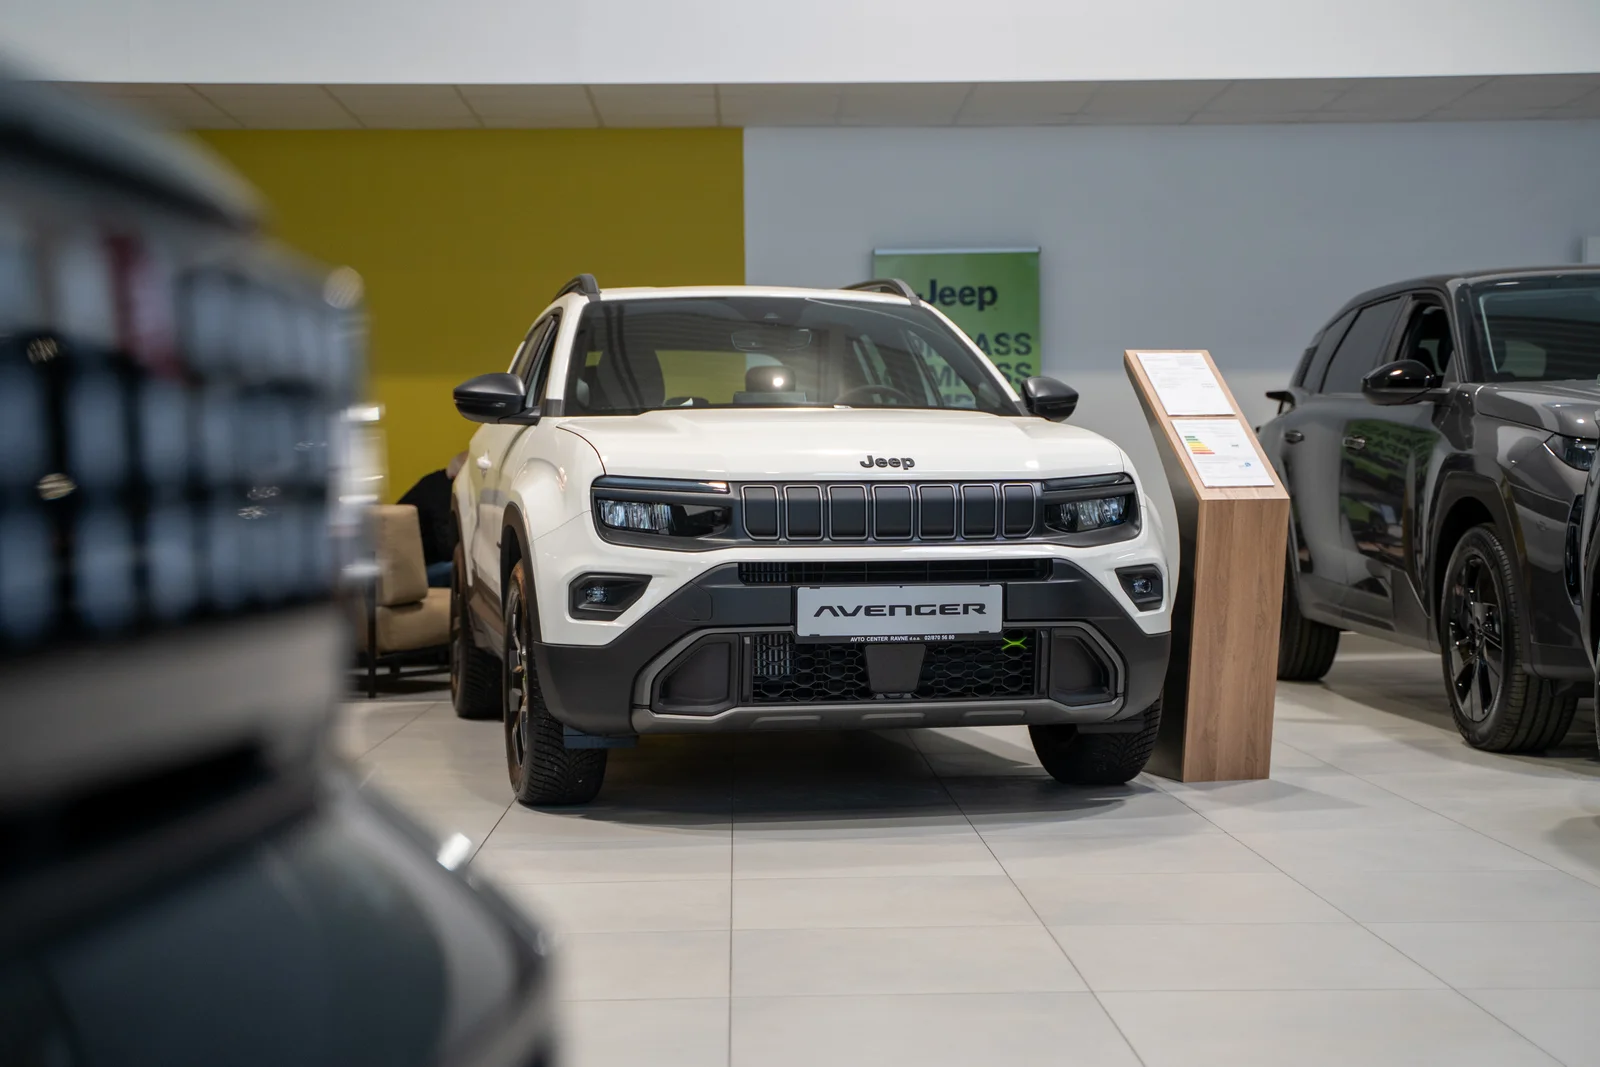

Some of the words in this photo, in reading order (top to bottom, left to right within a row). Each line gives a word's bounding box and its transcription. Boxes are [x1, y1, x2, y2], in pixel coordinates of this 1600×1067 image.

[916, 279, 998, 311] Jeep
[859, 454, 915, 470] Jeep
[813, 603, 987, 618] AVENGER
